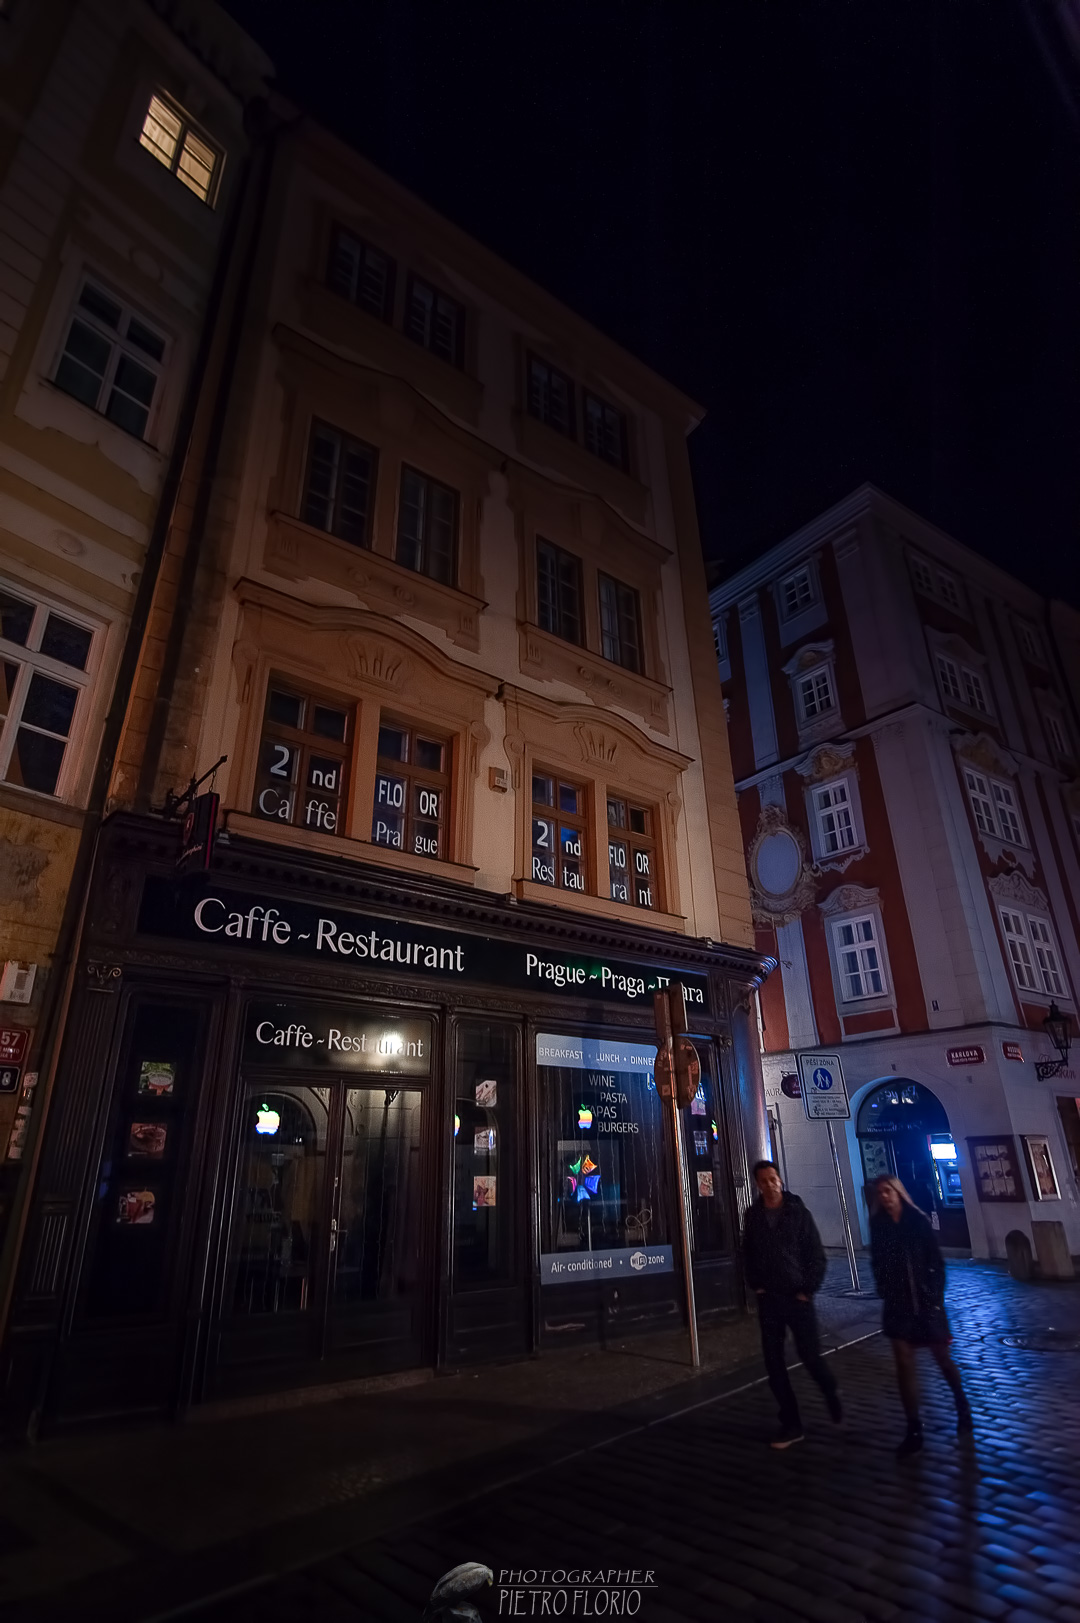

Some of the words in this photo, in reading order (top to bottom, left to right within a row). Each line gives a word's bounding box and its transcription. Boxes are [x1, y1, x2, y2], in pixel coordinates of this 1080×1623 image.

[270, 745, 290, 777] 2
[311, 769, 337, 790] nd
[378, 779, 403, 808] FLO
[419, 790, 438, 817] OR
[536, 820, 549, 848] 2
[565, 839, 582, 856] nd
[635, 852, 650, 875] OR
[193, 897, 292, 945] Caffe
[315, 918, 465, 972] Restaurant
[525, 953, 586, 987] Prague
[600, 966, 646, 998] Praga
[255, 1020, 314, 1049] Caffe
[538, 1047, 584, 1060] BREAKFAST
[595, 1053, 620, 1063] LUNCH
[951, 1049, 979, 1059] KARLOVA
[588, 1073, 616, 1088] WINE
[600, 1091, 628, 1104] PASTA
[598, 1121, 639, 1134] BURGERS
